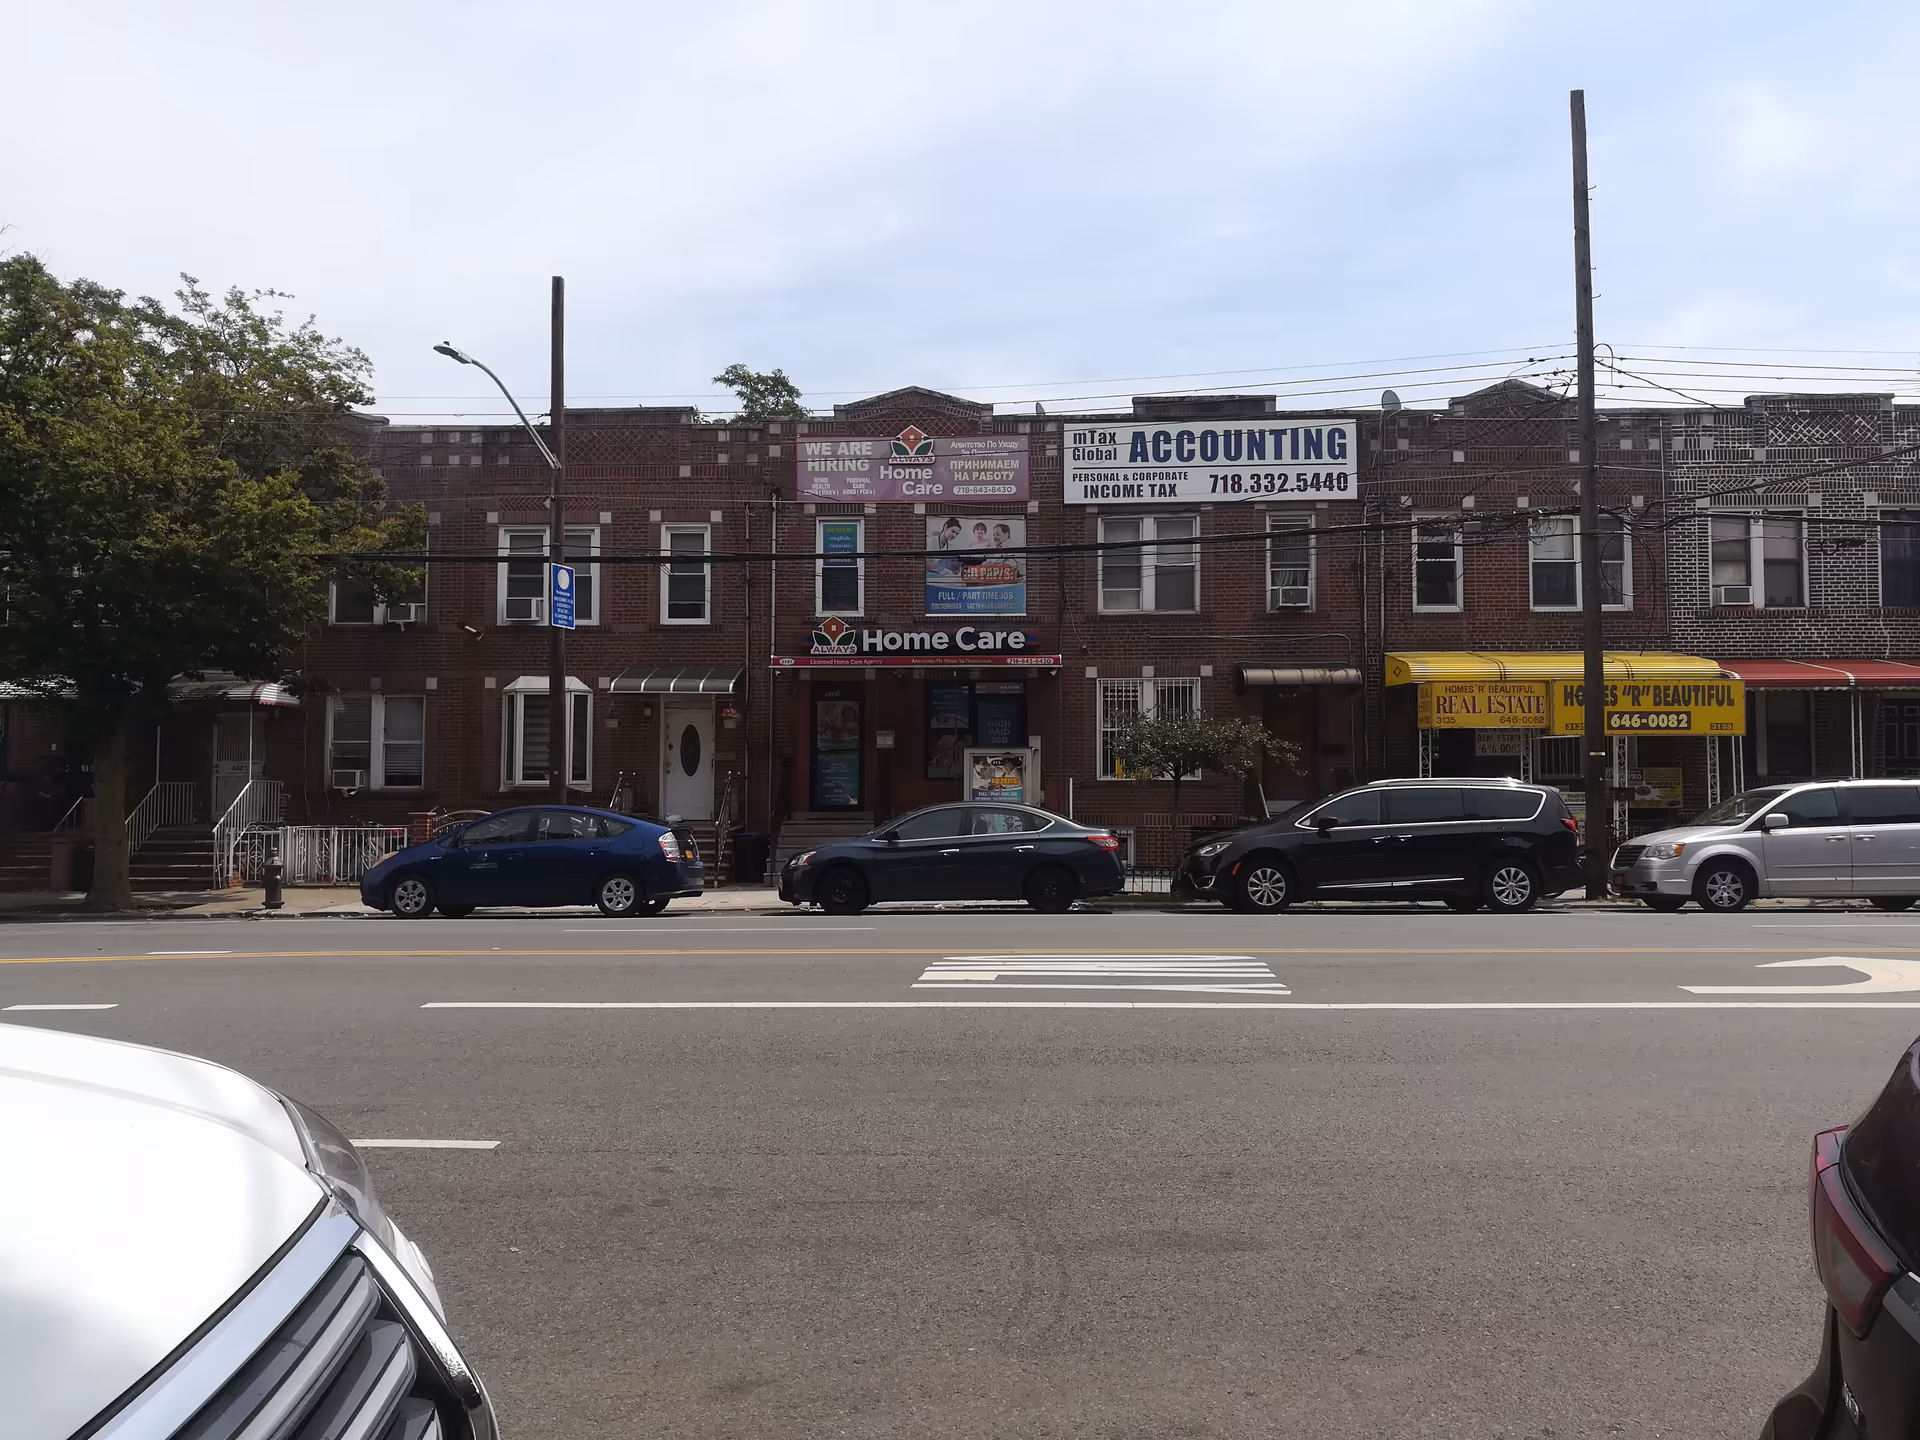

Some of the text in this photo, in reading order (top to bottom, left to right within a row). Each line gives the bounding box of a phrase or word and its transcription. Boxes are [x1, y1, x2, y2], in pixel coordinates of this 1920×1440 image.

[950, 441, 986, 449] Агентство
[998, 440, 1018, 449] Уходу
[1073, 430, 1117, 445] mTax
[806, 442, 872, 456] WE ARE
[1129, 428, 1348, 463] ACCOUNTING
[1073, 447, 1117, 461] Global
[808, 458, 869, 471] HIRING
[950, 460, 1019, 470] ПРИНИМАЕМ
[880, 466, 932, 480] Home
[955, 472, 1014, 480] НА РАБОТУ
[1073, 472, 1120, 482] PERSONAL
[1132, 471, 1189, 481] CORPORATE
[902, 481, 943, 495] Care
[1210, 472, 1348, 493] 718.332.5440
[1084, 484, 1177, 499] INCOME TAX
[938, 592, 956, 600] FULL
[962, 592, 980, 600] PART
[1000, 592, 1013, 600] JOB
[863, 626, 1026, 652] Home Care
[1488, 685, 1535, 693] BEAUTIFUL
[1563, 685, 1618, 707] HOES
[1653, 685, 1735, 707] BEAUTIFUL
[1435, 696, 1482, 715] REAL
[1487, 696, 1545, 715] ESTATE
[988, 720, 1010, 728] HIGH
[1500, 716, 1544, 724] 646-0082
[1610, 714, 1688, 728] 646-0082
[989, 728, 1010, 736] PAID
